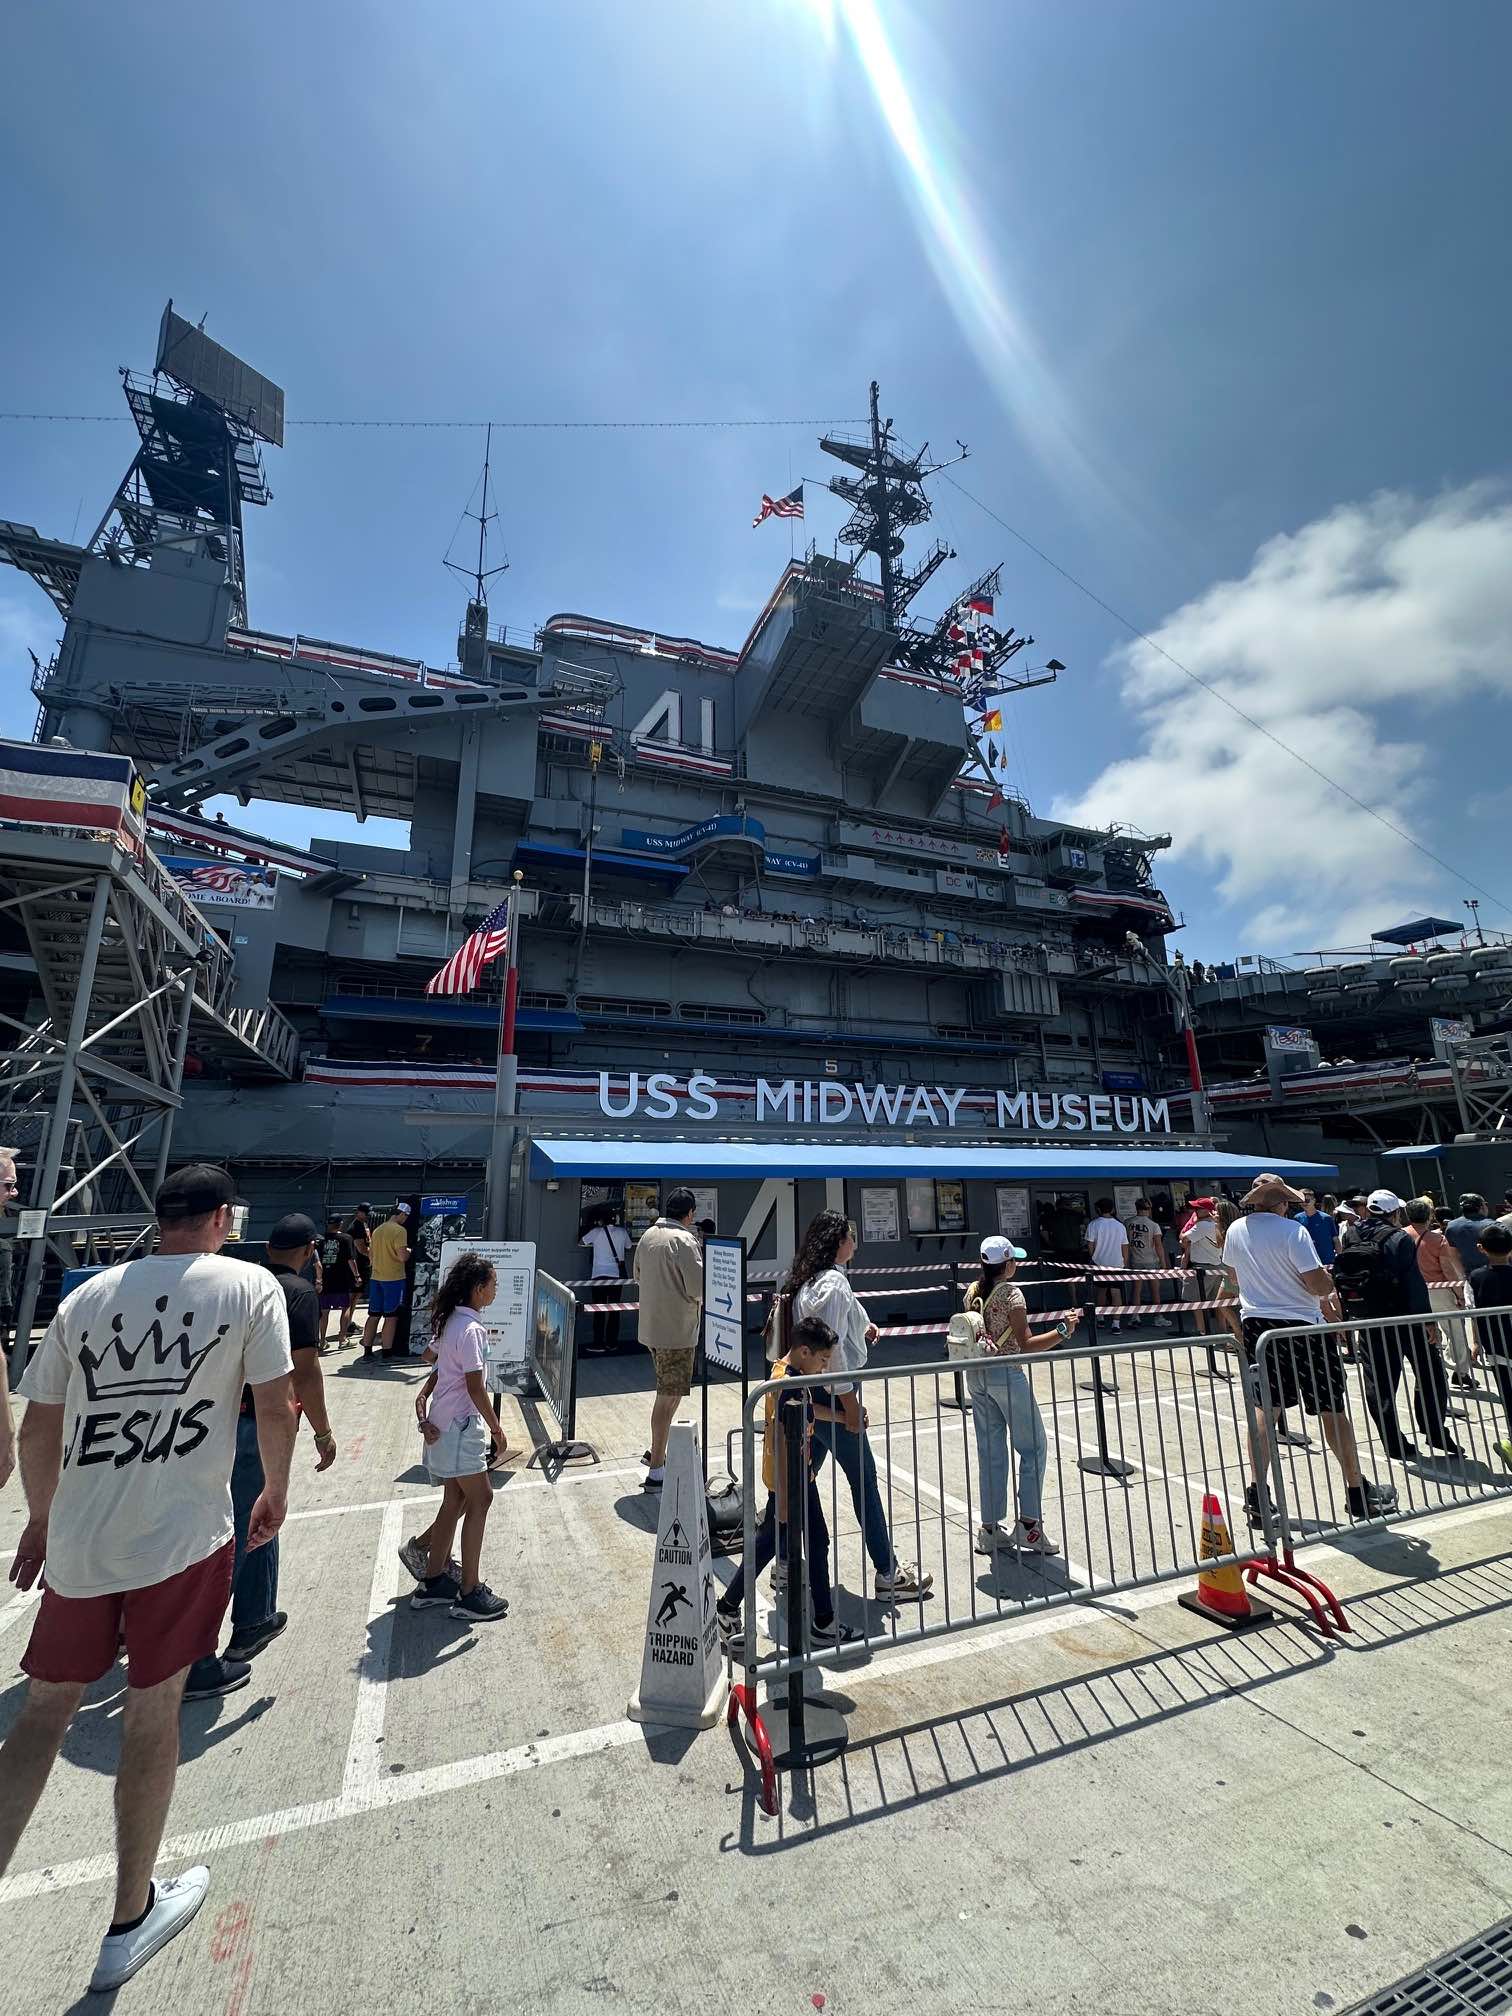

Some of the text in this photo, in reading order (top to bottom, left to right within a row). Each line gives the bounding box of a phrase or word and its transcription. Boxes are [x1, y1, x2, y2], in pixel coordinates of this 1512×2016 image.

[630, 690, 714, 756] 41
[646, 837, 663, 847] USS
[665, 832, 694, 848] MIDWAY
[945, 876, 975, 890] DC W
[209, 895, 251, 905] ABOARD!
[985, 886, 994, 898] C
[825, 1059, 838, 1073] 5
[600, 1071, 1171, 1133] USS MIDWAY MUSEUM
[659, 1548, 692, 1565] CAUTION
[649, 1631, 698, 1651] TRIPPING
[652, 1649, 694, 1666] HAZARD
